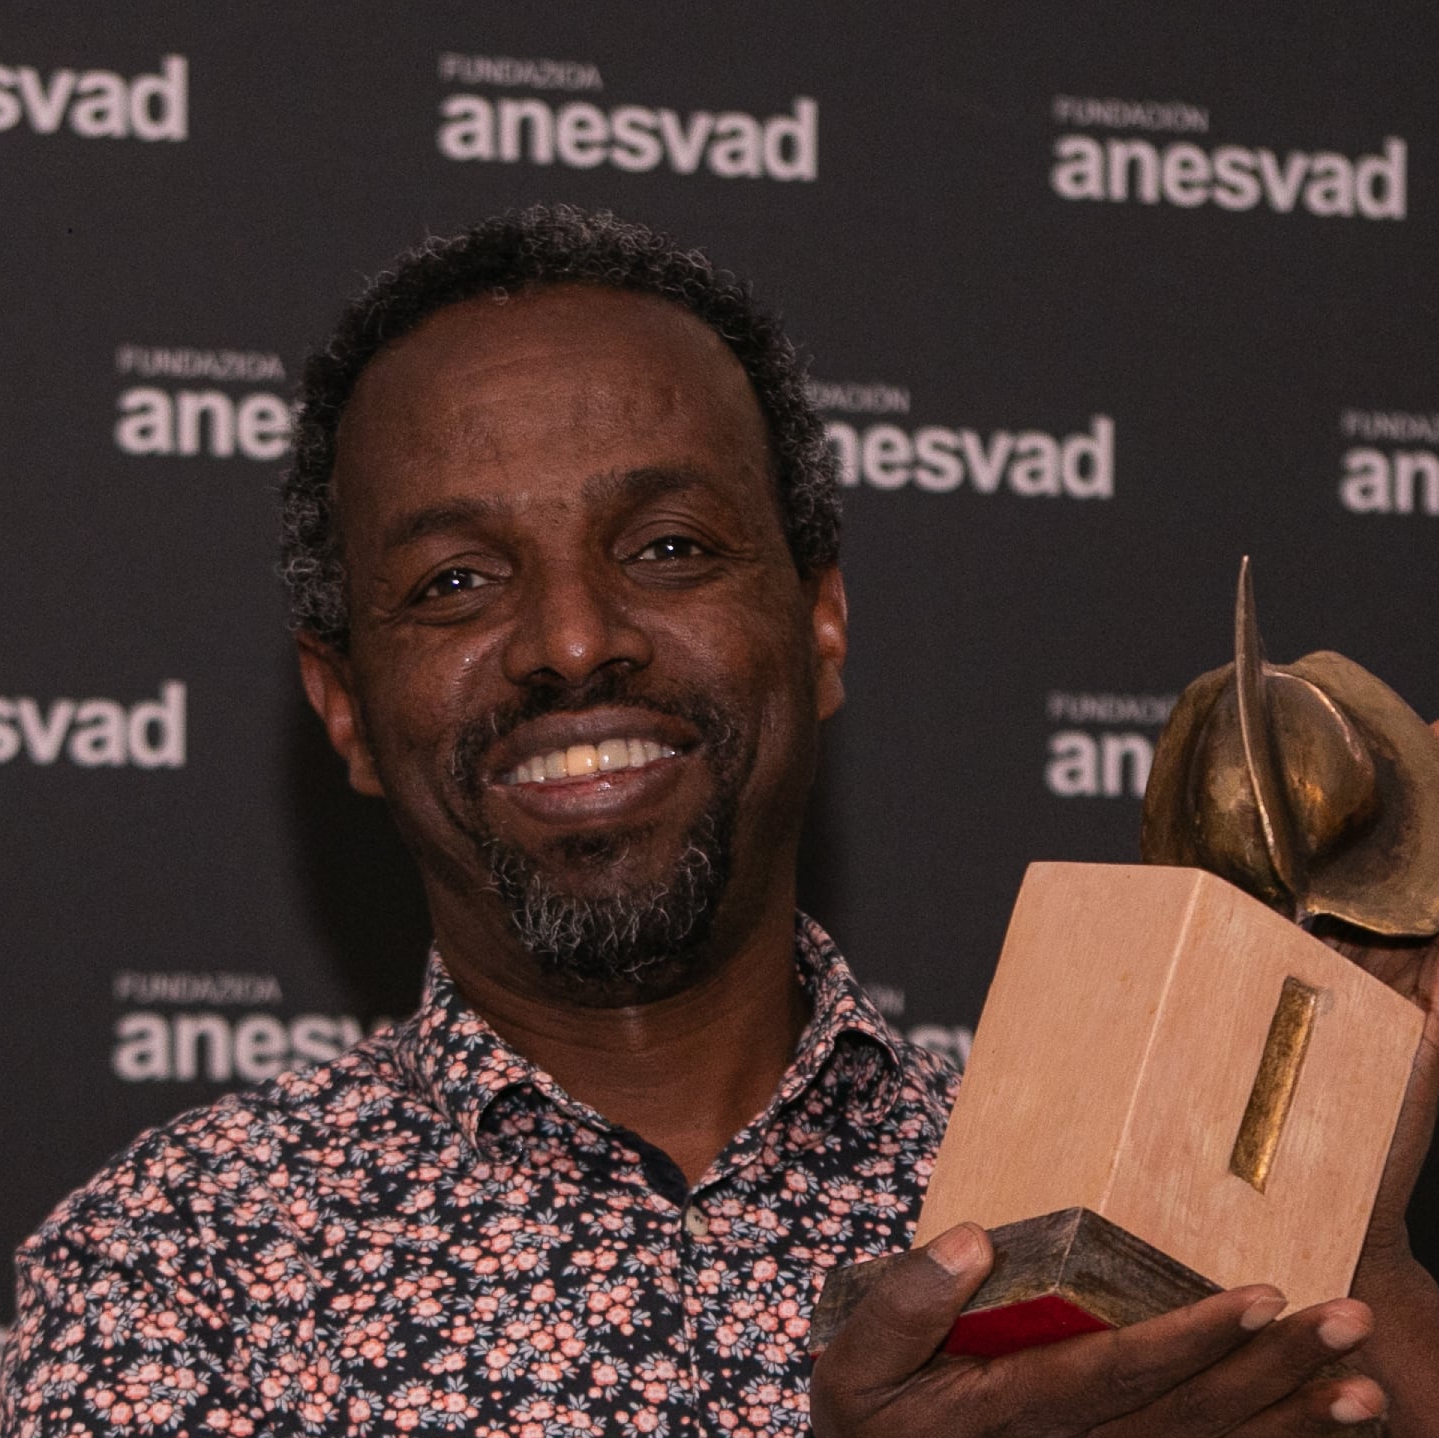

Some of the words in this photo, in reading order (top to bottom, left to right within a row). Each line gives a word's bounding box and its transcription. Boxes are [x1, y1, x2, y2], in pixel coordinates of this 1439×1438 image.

[439, 93, 817, 182] anesvad
[1052, 134, 1406, 220] anesvad
[822, 416, 1115, 499] nesvad
[114, 1012, 360, 1082] anes
